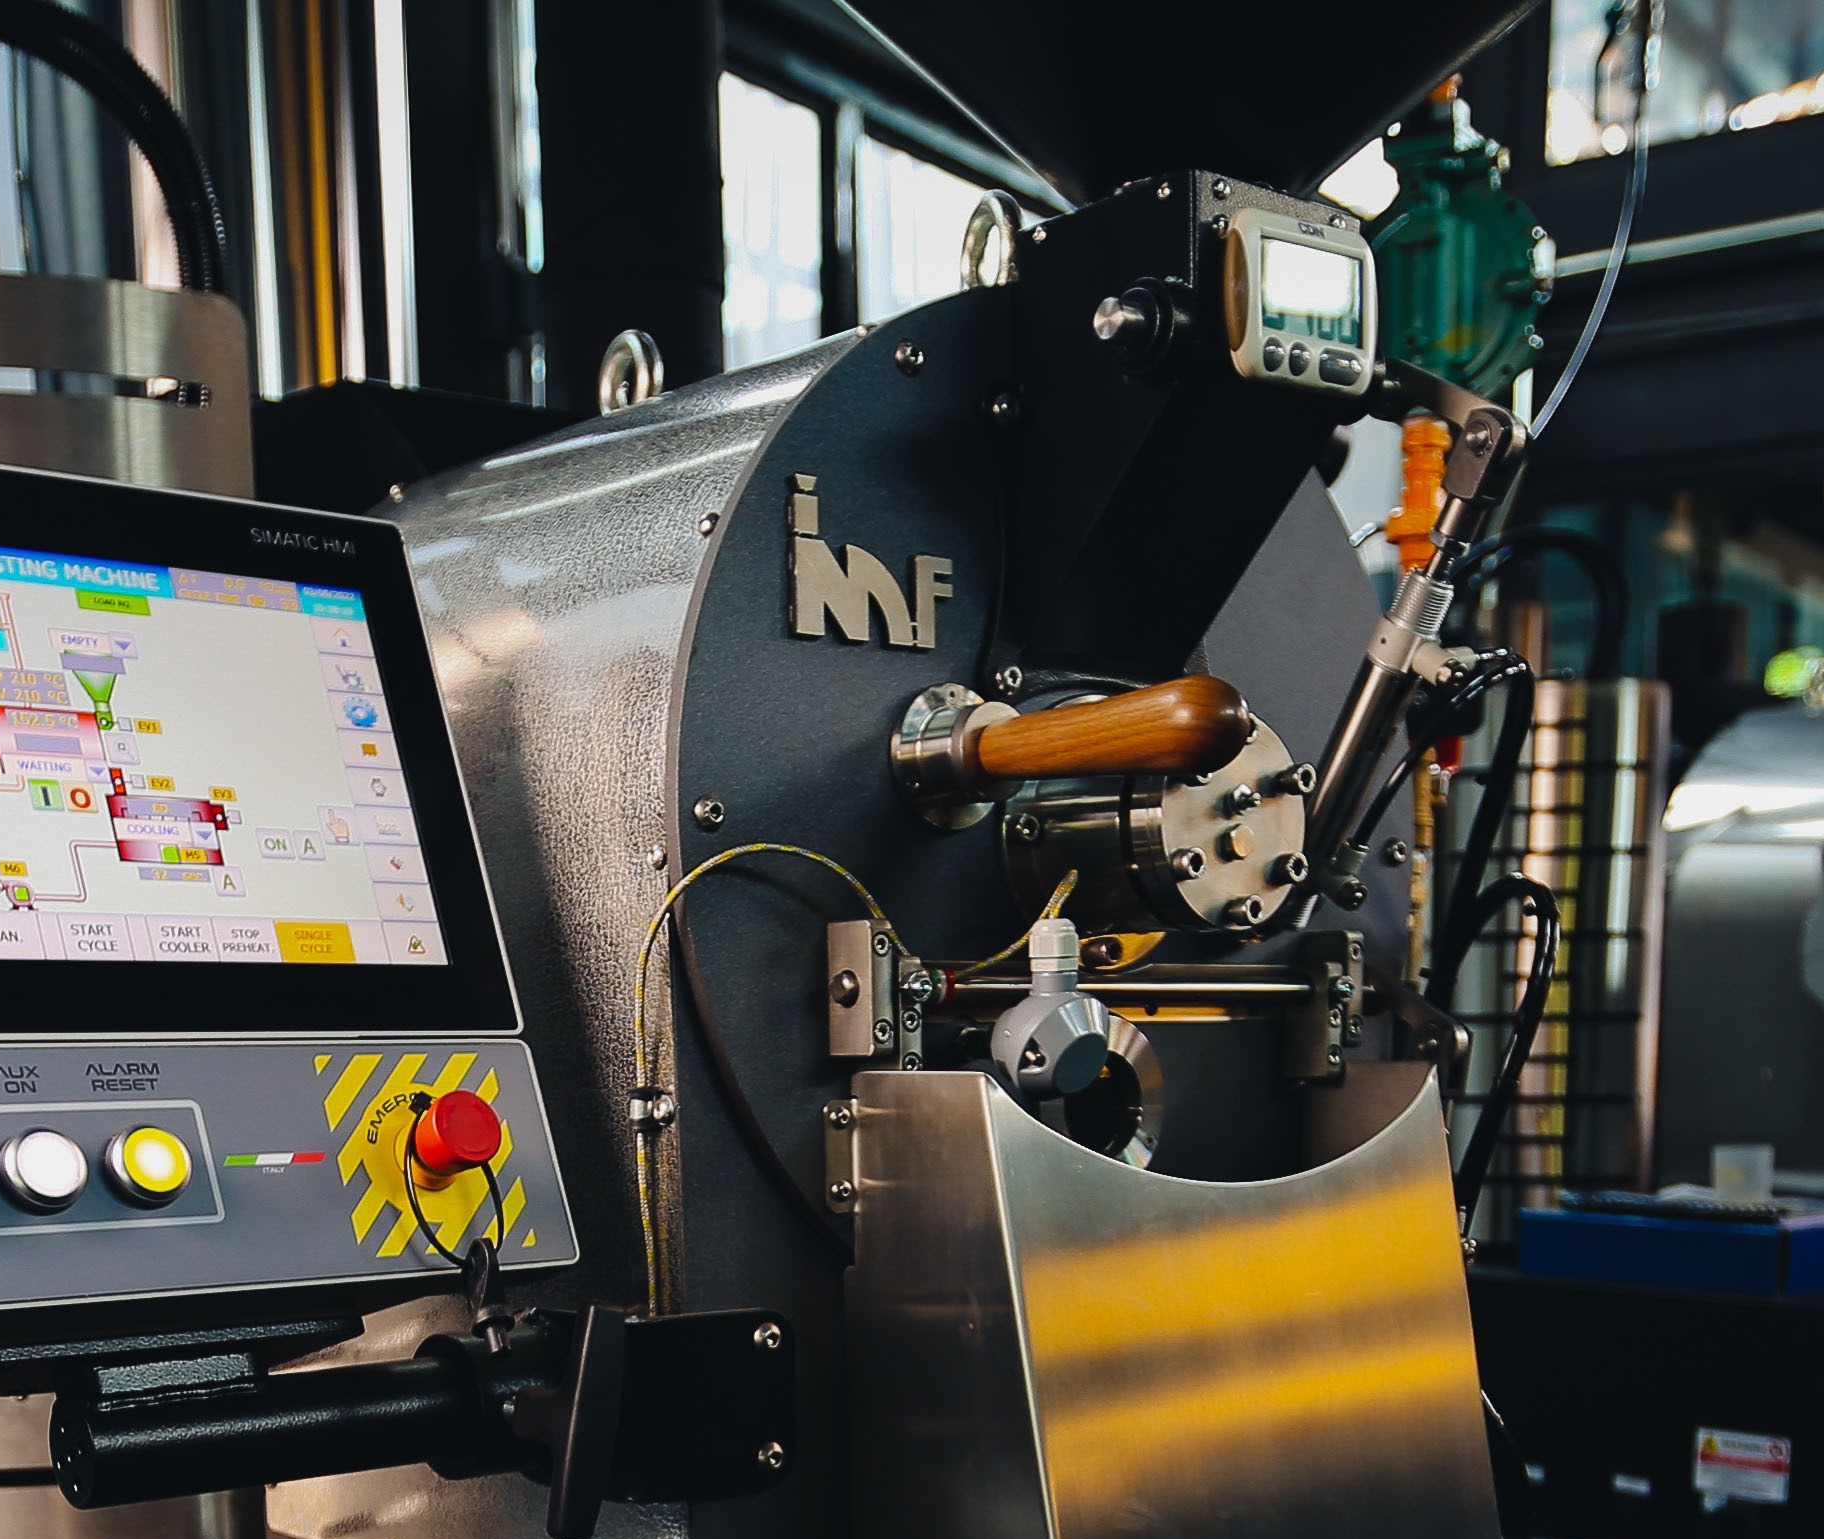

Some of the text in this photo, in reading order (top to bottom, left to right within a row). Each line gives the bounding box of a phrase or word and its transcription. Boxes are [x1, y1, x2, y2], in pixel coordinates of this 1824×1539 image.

[1298, 222, 1325, 238] CDN
[251, 528, 356, 554] SIMATIC HMI
[64, 563, 160, 591] MACHINE
[61, 634, 98, 648] EMPTY
[11, 711, 55, 728] 152.5
[138, 721, 157, 731] EV1
[17, 760, 72, 773] WAITING
[151, 778, 170, 788] EV2
[213, 788, 232, 798] EV3
[127, 824, 180, 836] COOLING
[264, 838, 287, 851] ON
[303, 837, 316, 853] A
[224, 874, 236, 890] A
[70, 924, 113, 936] START
[160, 926, 201, 937] START
[231, 929, 259, 939] STOP
[294, 930, 333, 940] SINGLE
[77, 940, 119, 952] CYCLE
[159, 942, 210, 953] COOLER
[299, 943, 333, 954] CYCLE
[85, 1062, 160, 1077] ALARM
[4, 1080, 37, 1094] ON
[91, 1078, 158, 1092] RESET
